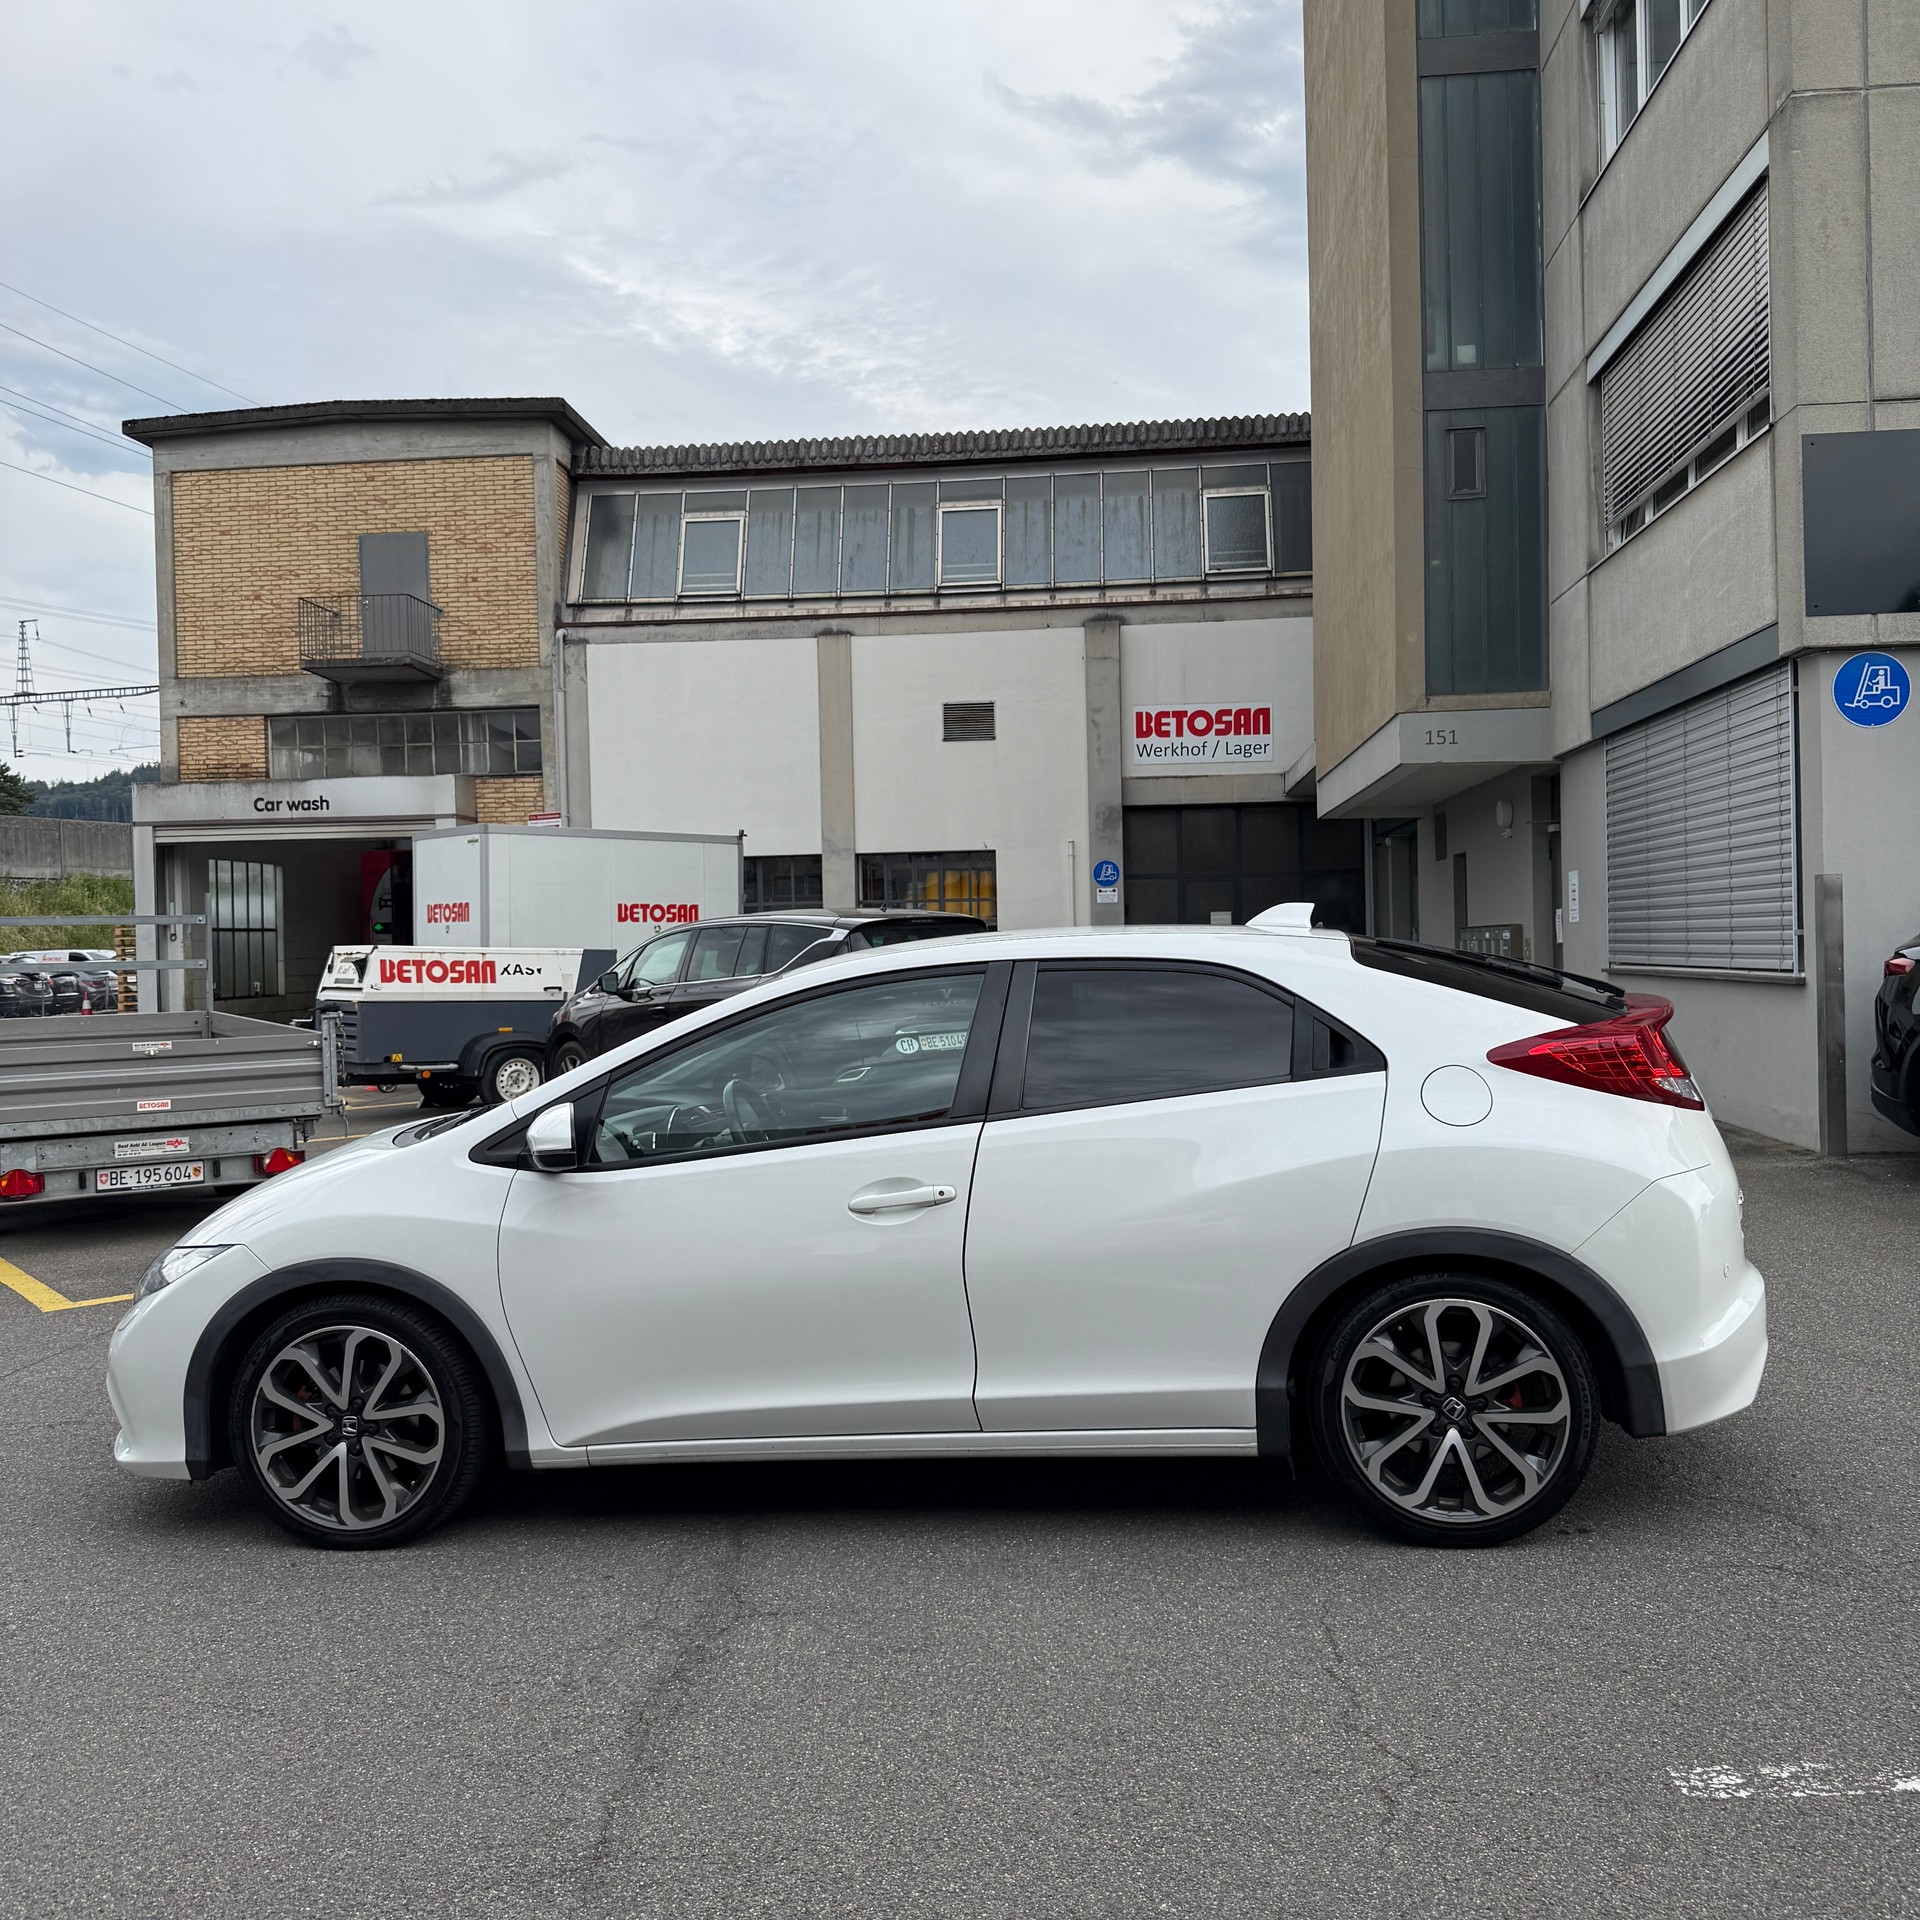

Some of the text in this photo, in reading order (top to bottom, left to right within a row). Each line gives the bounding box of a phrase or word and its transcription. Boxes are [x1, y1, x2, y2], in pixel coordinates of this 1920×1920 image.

[1135, 707, 1271, 739] BETOSAN
[1425, 729, 1458, 746] 151
[1136, 741, 1207, 759] Werkhof
[1225, 740, 1270, 758] Lager
[254, 795, 330, 812] Car wash
[427, 902, 470, 924] BETOSAN
[618, 903, 699, 923] BETOSAN
[380, 959, 497, 984] BETOSAN
[900, 1038, 915, 1052] CH
